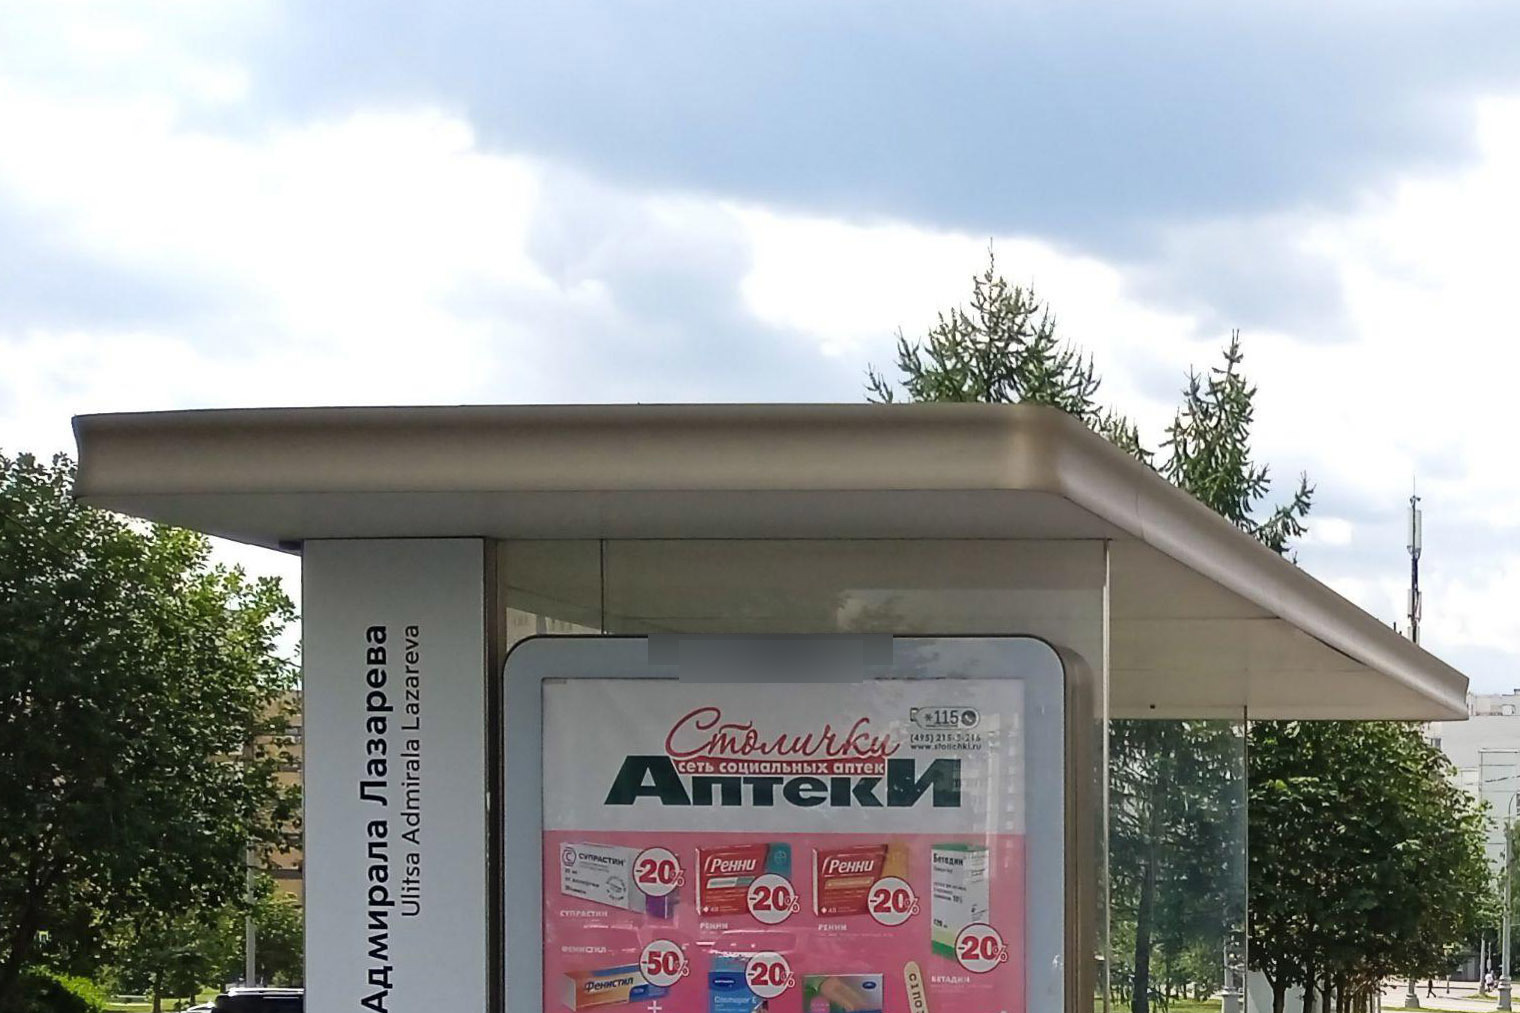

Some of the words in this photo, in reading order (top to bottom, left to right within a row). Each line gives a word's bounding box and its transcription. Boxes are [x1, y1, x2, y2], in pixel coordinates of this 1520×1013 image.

[400, 624, 421, 731] Lazareva
[359, 624, 394, 807] Лазарева
[665, 706, 901, 757] Столички
[678, 763, 714, 774] сеть
[719, 762, 827, 775] социальных
[832, 764, 885, 775] аптек
[400, 738, 421, 846] Admirala
[578, 852, 624, 867] СУПРАСТИН
[635, 858, 685, 887] -20%
[710, 857, 757, 873] Ренни
[828, 857, 875, 873] Ренни
[933, 852, 964, 866] Бетадин
[401, 854, 421, 917] Ulitsa
[749, 885, 800, 913] -20%
[869, 888, 920, 916] -20%
[957, 935, 1009, 963] -20%
[641, 950, 690, 977] -50%
[747, 962, 796, 988] -20%
[585, 977, 634, 992] Фенистил
